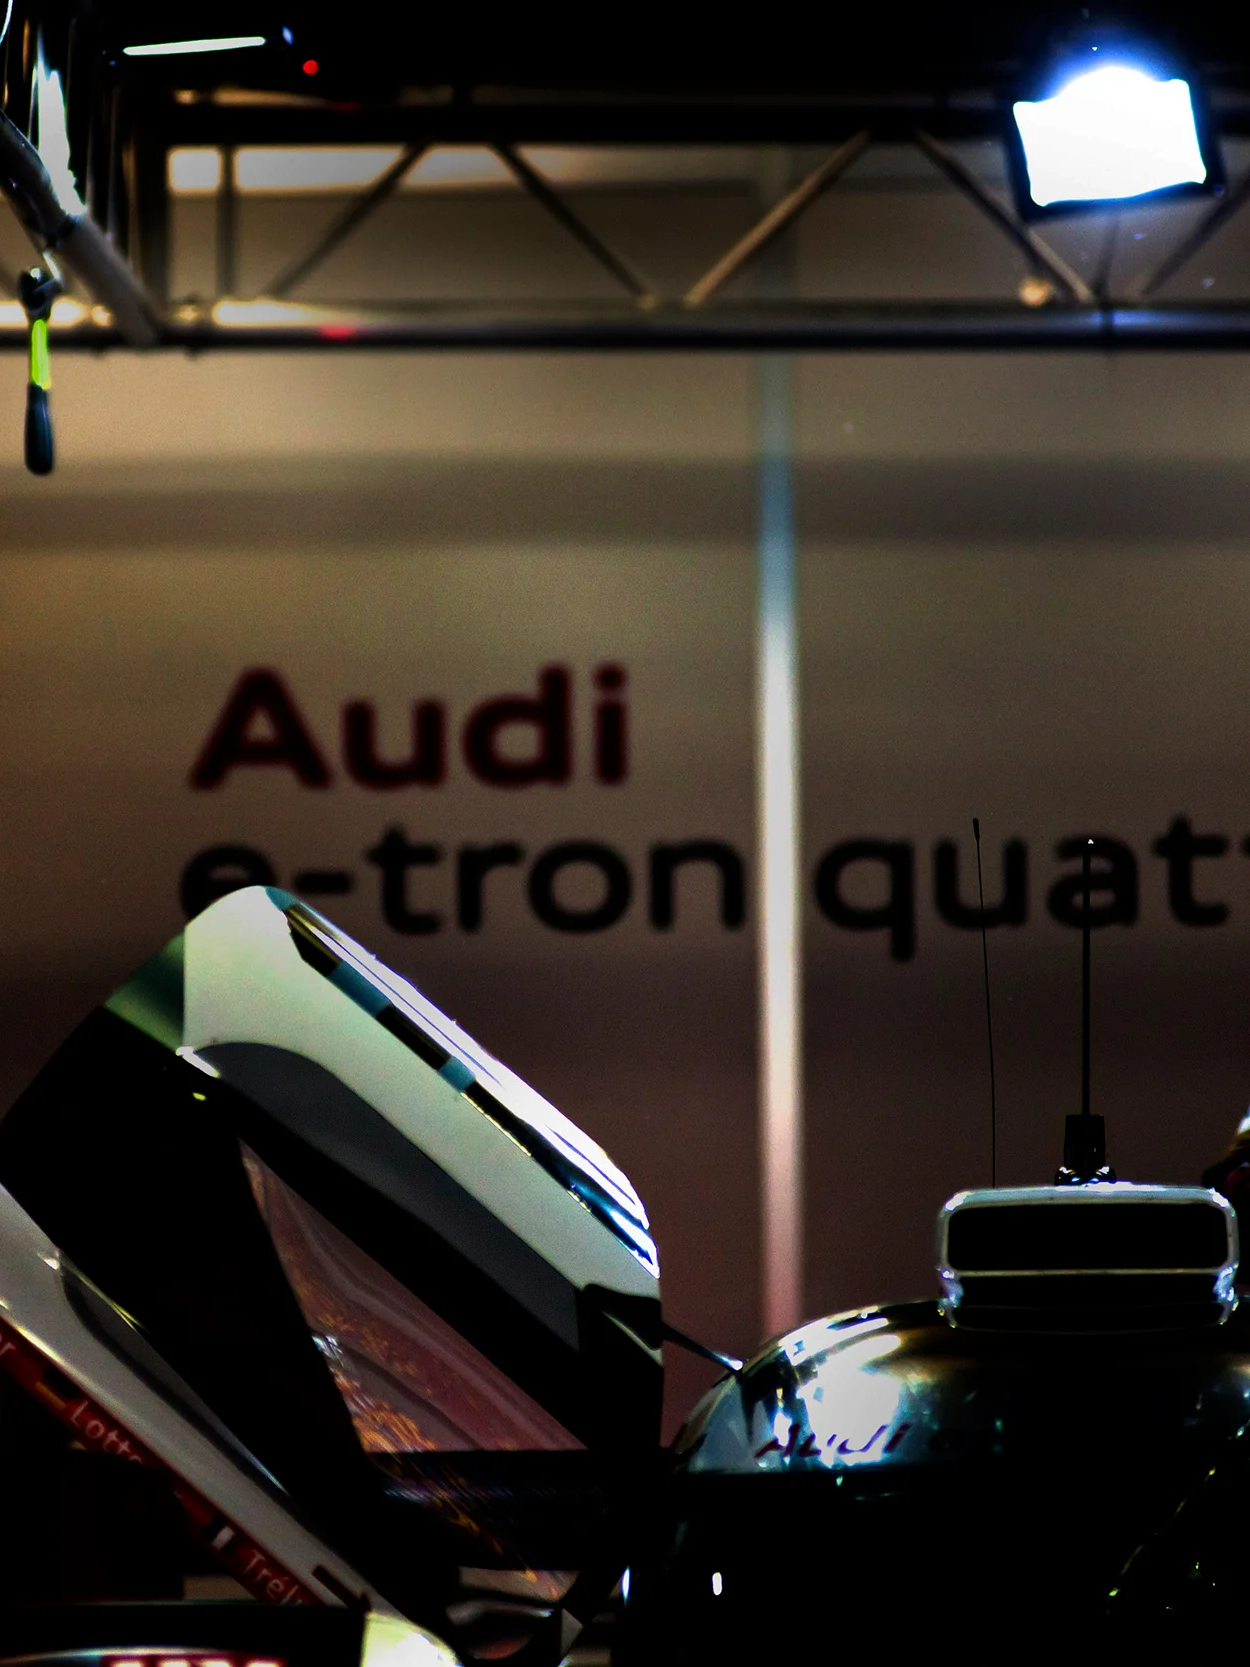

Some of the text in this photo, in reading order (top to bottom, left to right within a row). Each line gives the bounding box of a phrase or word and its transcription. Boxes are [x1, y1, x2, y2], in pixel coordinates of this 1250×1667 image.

[188, 662, 630, 792] Audi
[179, 816, 1250, 962] e-tron quat
[241, 1548, 304, 1606] Trél
